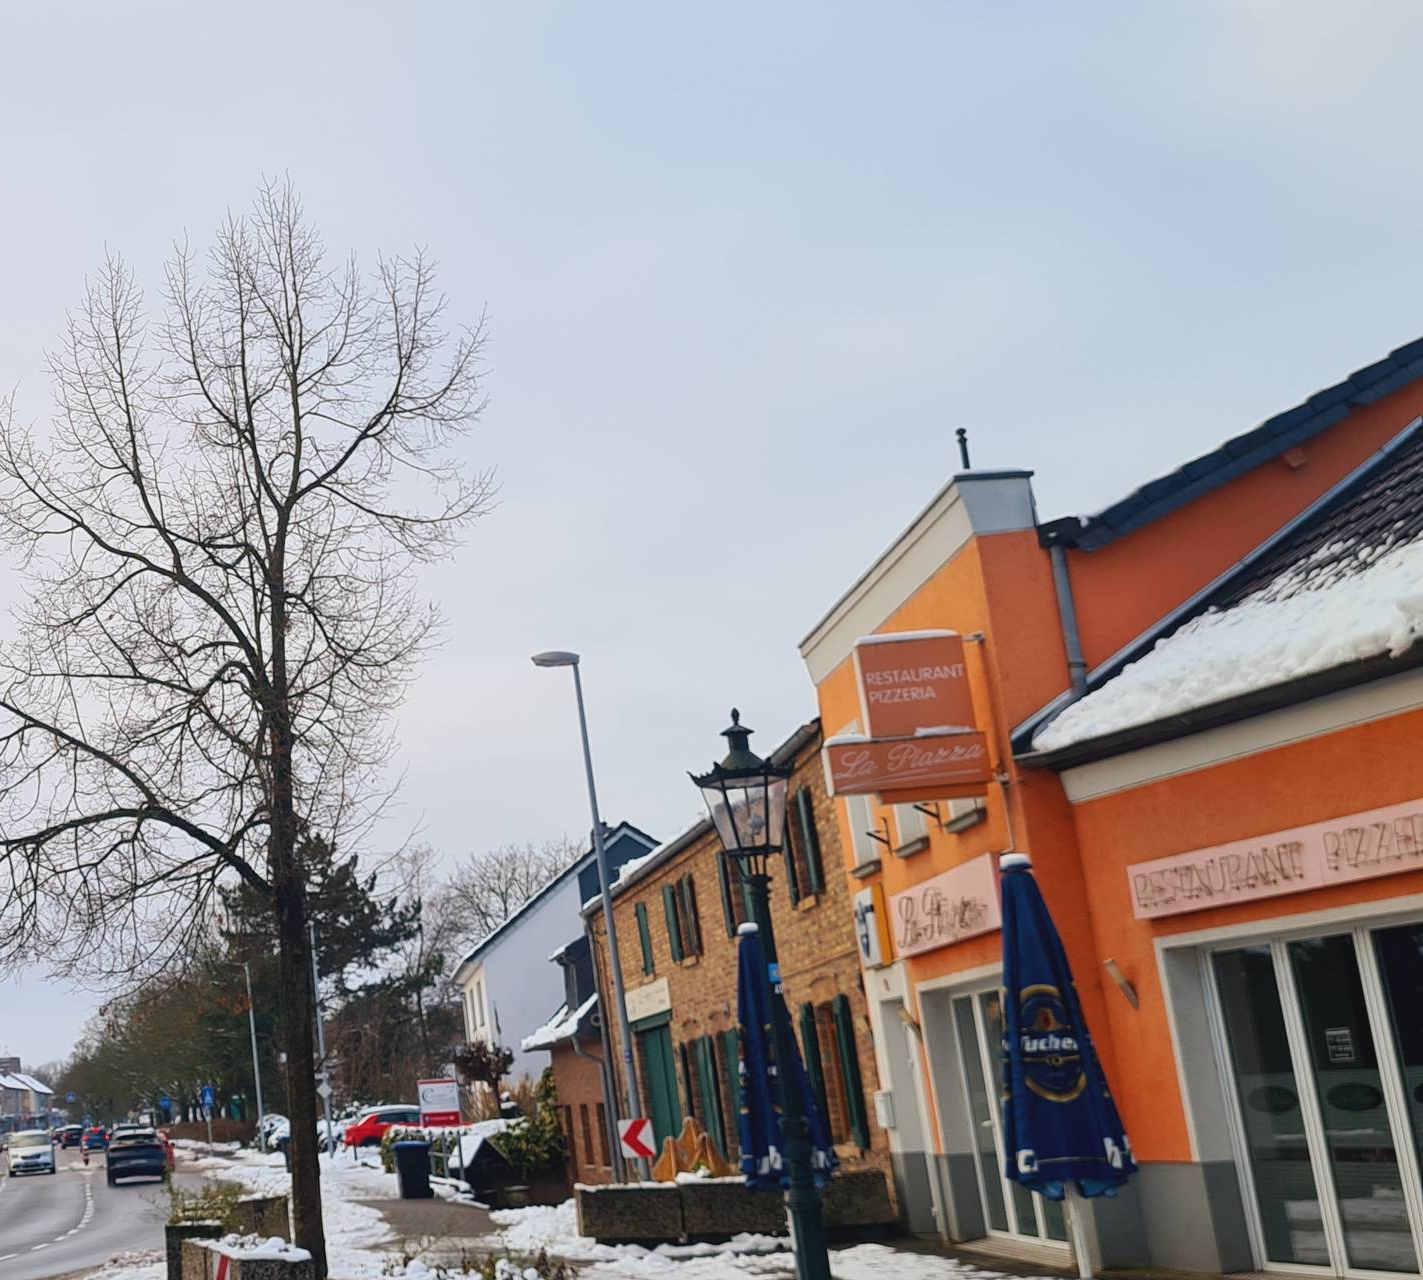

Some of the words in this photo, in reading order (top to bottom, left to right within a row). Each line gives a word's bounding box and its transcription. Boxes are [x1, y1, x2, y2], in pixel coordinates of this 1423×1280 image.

[865, 663, 965, 685] RESTAURANT
[868, 685, 937, 704] PIZZERIA
[834, 750, 877, 779] La
[886, 743, 985, 772] Piazza
